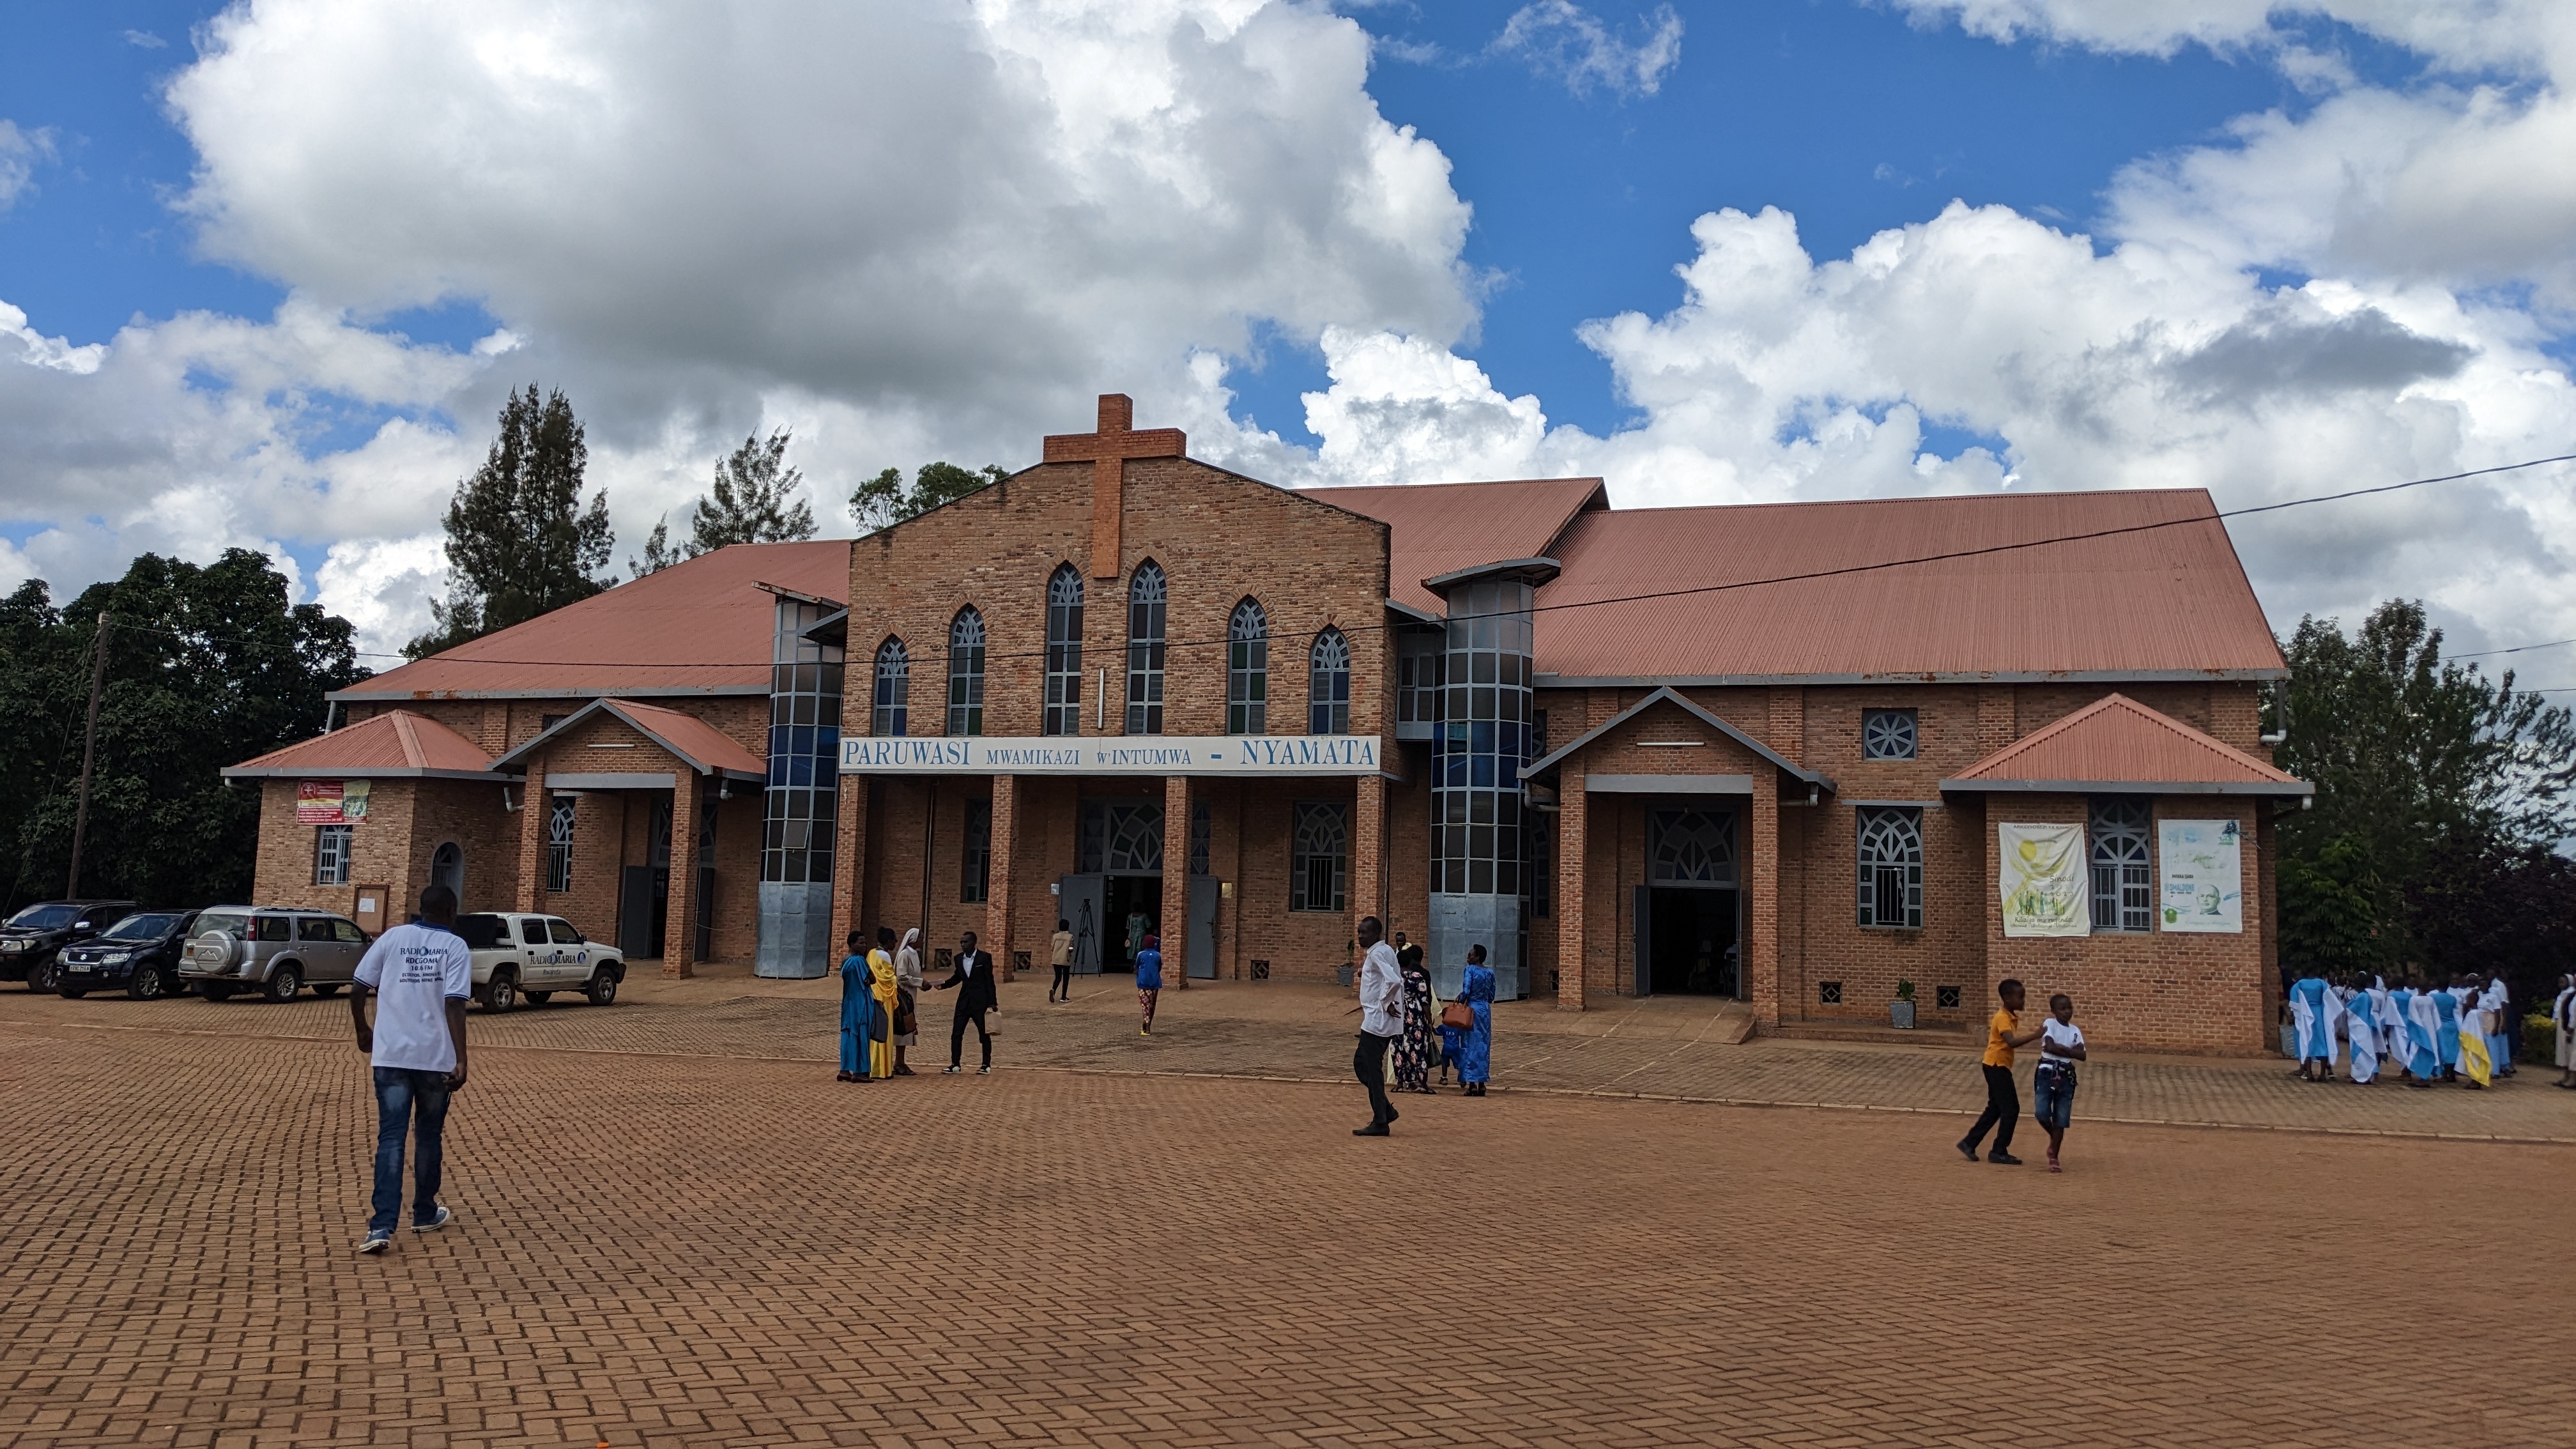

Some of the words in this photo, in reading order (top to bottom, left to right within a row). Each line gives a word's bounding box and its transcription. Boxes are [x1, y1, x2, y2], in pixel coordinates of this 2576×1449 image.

[844, 740, 970, 765] PARUWASI
[986, 749, 1080, 765] MWAMIKAZI
[1240, 739, 1376, 765] NYAMATA
[530, 955, 553, 965] RADIO
[555, 954, 576, 964] MARIA
